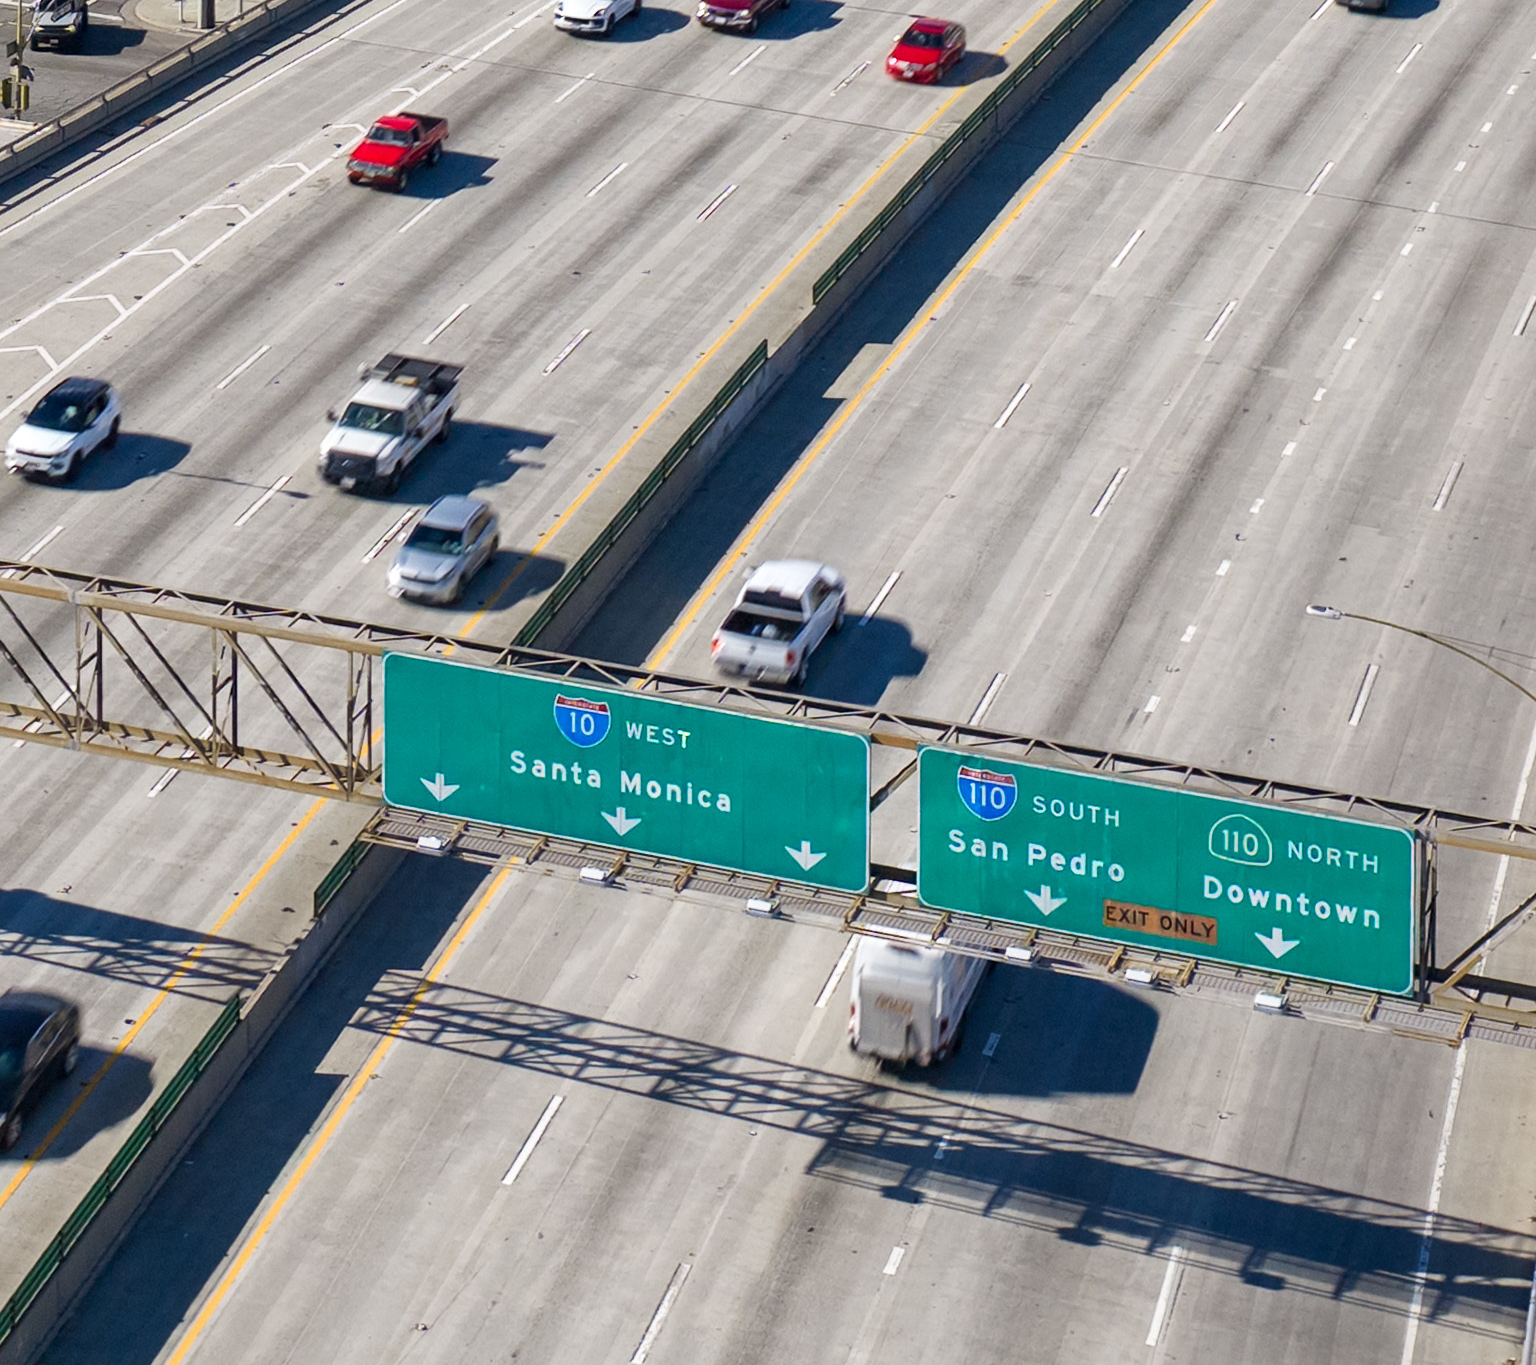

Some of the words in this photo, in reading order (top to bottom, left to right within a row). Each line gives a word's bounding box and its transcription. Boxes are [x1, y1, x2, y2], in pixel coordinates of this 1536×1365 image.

[570, 711, 595, 736] 10
[626, 721, 691, 749] WEST
[510, 750, 601, 789] Santa
[620, 770, 731, 812] Monica
[969, 782, 1006, 810] 110
[1033, 795, 1121, 828] SOUTH
[948, 829, 1008, 862] San
[1028, 843, 1126, 883] Pedro
[1222, 829, 1259, 857] 110
[1288, 841, 1379, 875] NORTH
[1105, 905, 1149, 928] EXIT
[1159, 914, 1216, 939] ONLY
[1203, 875, 1381, 929] Downtown
